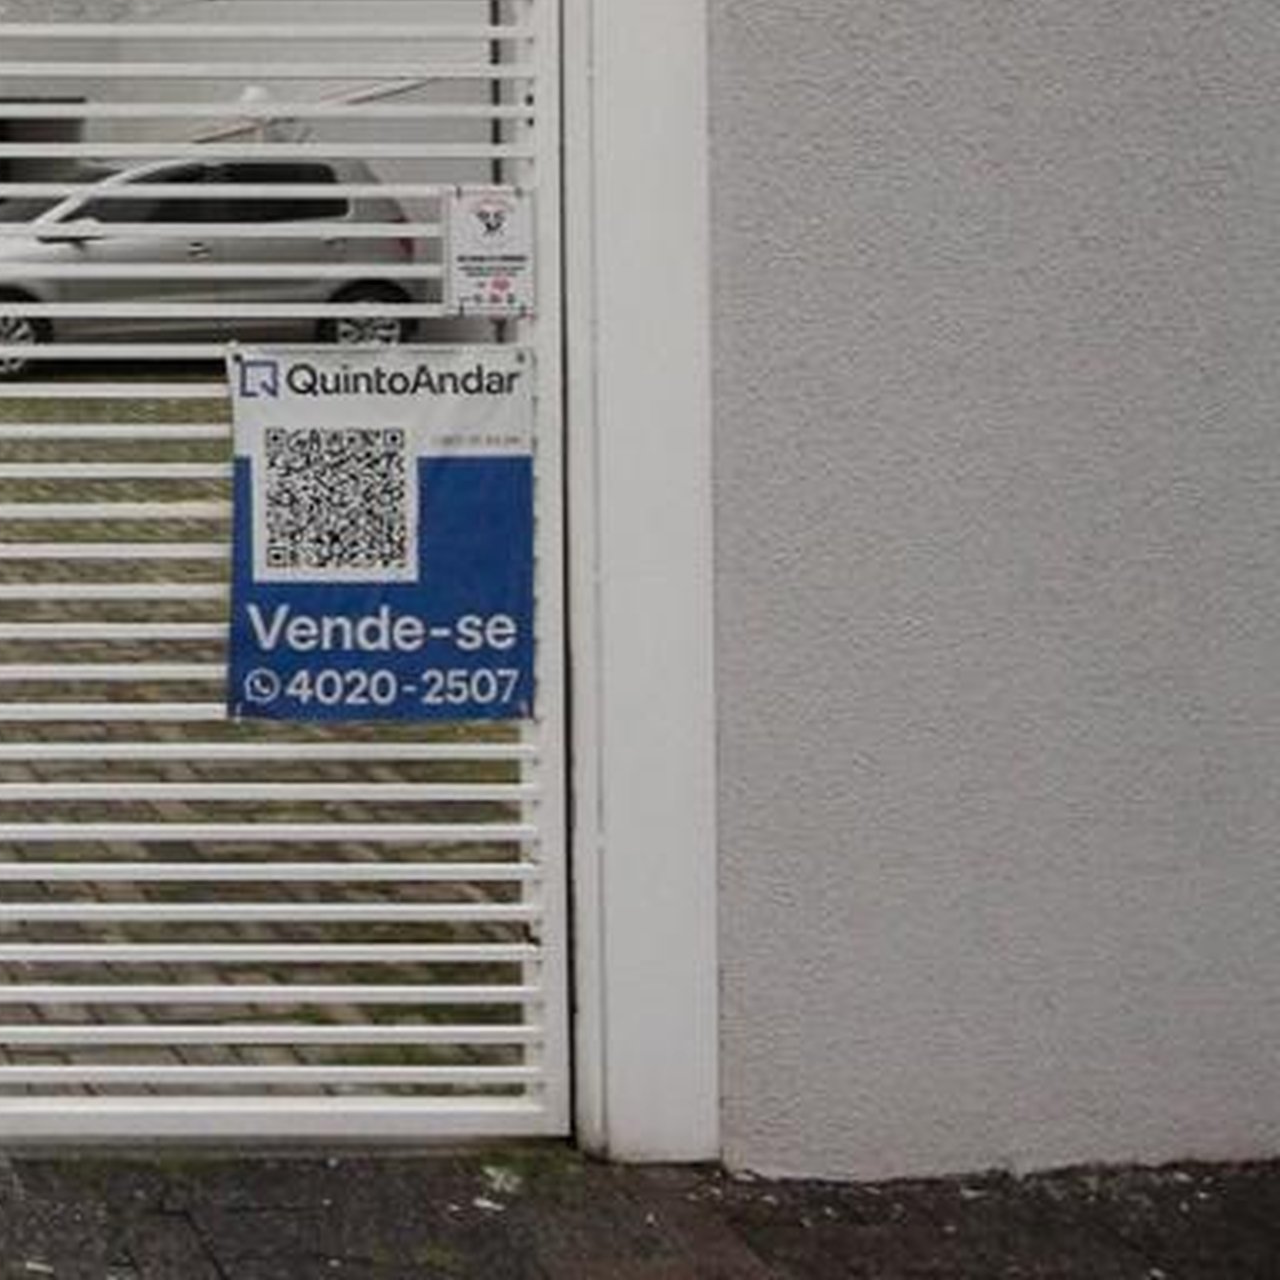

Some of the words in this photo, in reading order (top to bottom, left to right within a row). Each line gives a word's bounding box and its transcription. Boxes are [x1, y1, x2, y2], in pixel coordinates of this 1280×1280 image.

[286, 364, 521, 396] QuintoAndar
[246, 603, 518, 652] Vende-se
[285, 669, 520, 705] 4020-2507
